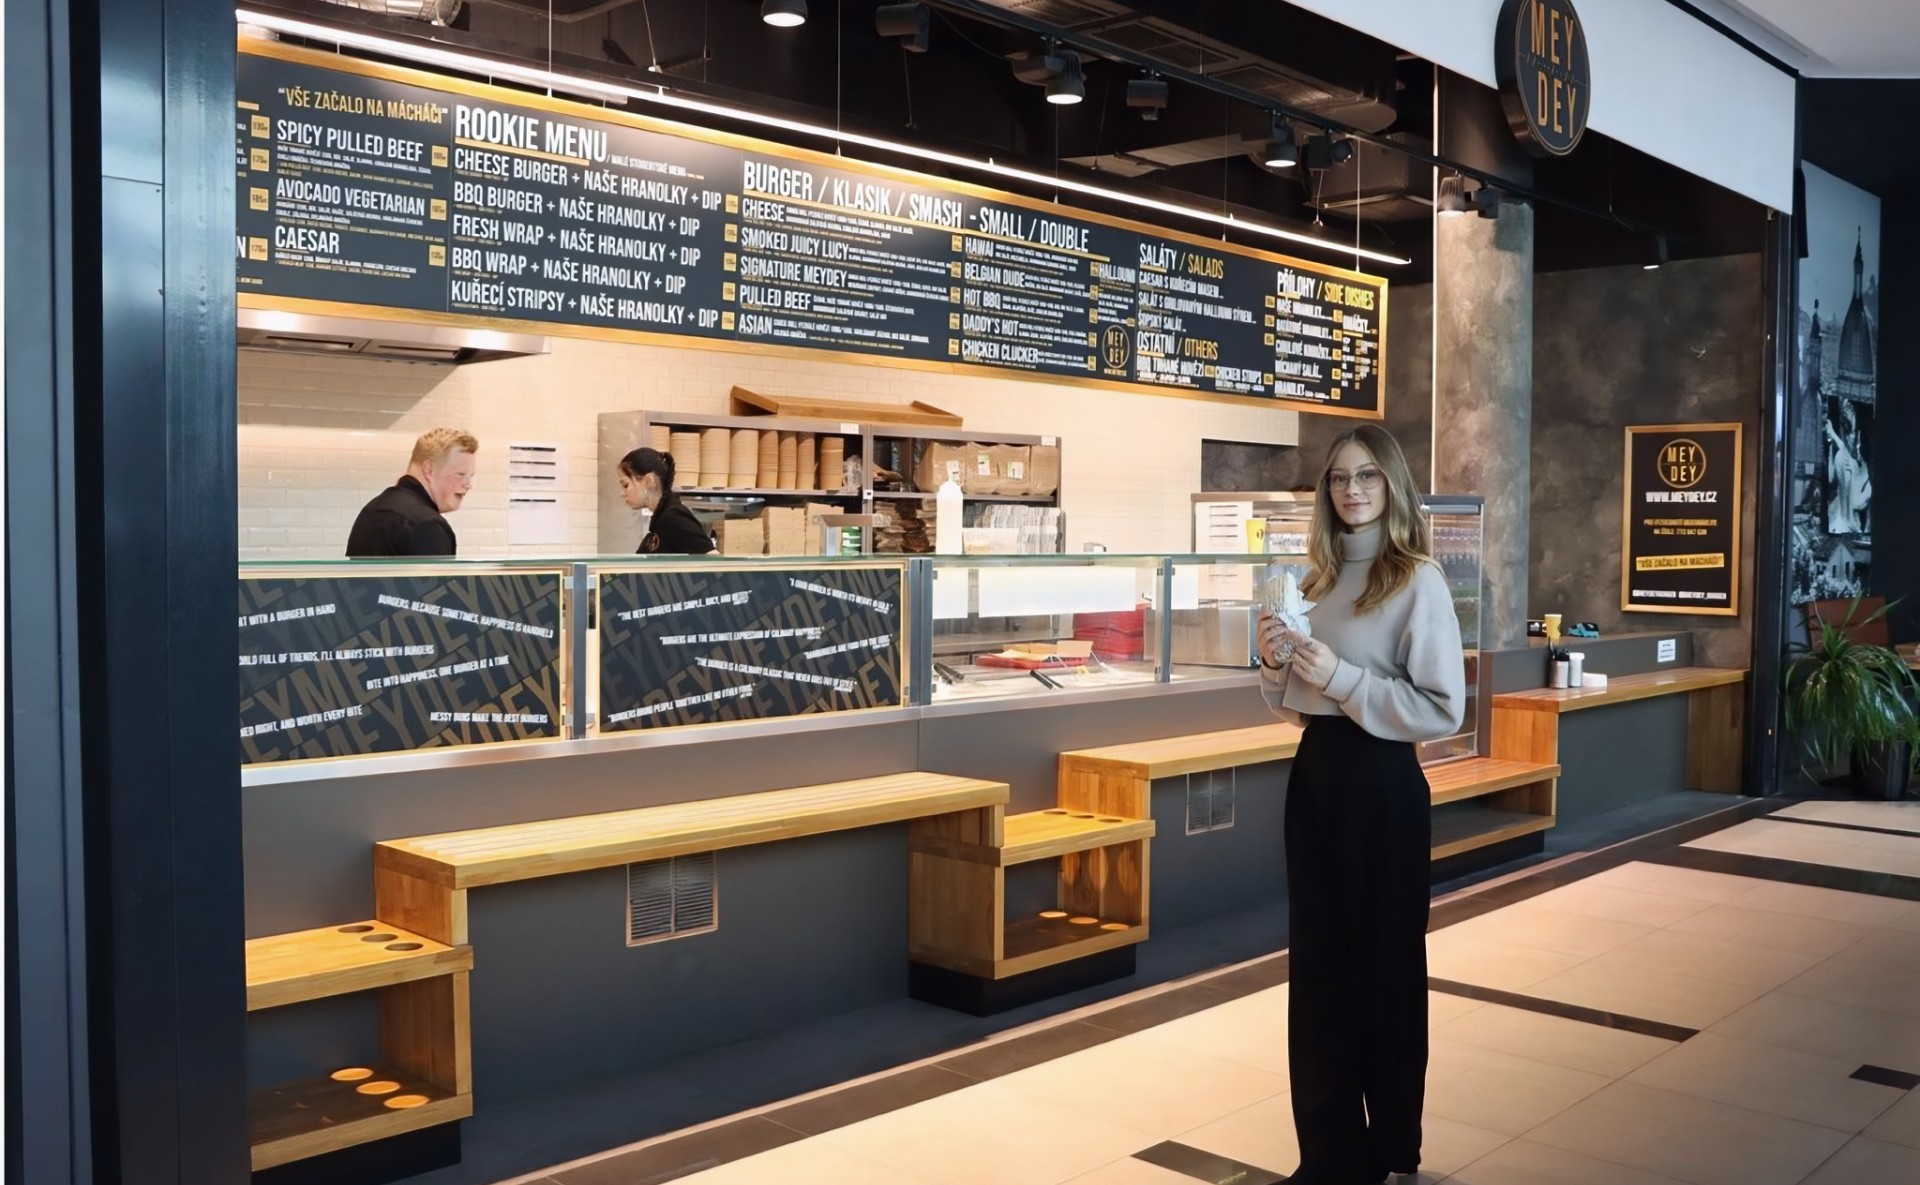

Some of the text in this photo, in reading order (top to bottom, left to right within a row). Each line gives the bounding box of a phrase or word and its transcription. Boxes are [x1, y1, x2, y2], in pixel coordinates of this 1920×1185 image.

[1531, 0, 1574, 71] MEY
[314, 90, 363, 114] ZAČALO
[367, 98, 384, 117] NA
[1538, 71, 1576, 139] DEY
[277, 119, 323, 146] SPICY
[327, 128, 383, 155] PULLED
[388, 137, 424, 162] BEEF
[456, 105, 539, 151] ROOKIE
[545, 121, 607, 163] MENU
[455, 149, 510, 177] CHEESE
[513, 159, 568, 186] BURGER
[571, 173, 581, 184] +
[584, 169, 618, 195] NAŠE
[621, 177, 688, 206] HRANOLKY
[691, 193, 699, 204] +
[703, 191, 722, 212] DIP
[276, 178, 426, 217] AVOCADO VEGETARIAN
[454, 181, 700, 237] BBQ BURGER + NAŠE HRANOLKY + DIP
[743, 198, 785, 222] CHEESE
[744, 160, 813, 202] BURGER
[818, 176, 829, 203] /
[834, 178, 892, 217] KLASIK
[894, 191, 906, 217] /
[910, 193, 963, 229] SMASH
[980, 207, 1025, 241] SMALL
[1028, 218, 1037, 242] /
[1040, 220, 1090, 253] DOUBLE
[275, 225, 340, 255] CAESAR
[453, 214, 499, 240] FRESH
[503, 223, 544, 246] WRAP
[548, 232, 557, 243] +
[560, 229, 595, 253] NAŠE
[599, 235, 666, 263] HRANOLKY
[669, 249, 678, 260] +
[681, 247, 701, 267] DIP
[742, 227, 787, 251] SMOKED
[790, 235, 820, 256] JUICY
[823, 239, 849, 261] LUCY
[452, 248, 482, 272] BBQ
[486, 254, 527, 276] WRAP
[531, 262, 540, 273] +
[544, 258, 579, 282] NAŠE
[583, 264, 652, 292] HRANOLKY
[654, 278, 662, 288] +
[666, 275, 686, 295] DIP
[741, 256, 801, 282] SIGNATURE
[804, 266, 848, 288] MEYDEY
[965, 263, 1001, 284] BELGIAN
[1003, 270, 1025, 288] DUDE
[1140, 243, 1177, 271] SALÁTY
[1188, 254, 1224, 280] SALADS
[1139, 271, 1163, 288] CAESAR
[1278, 268, 1316, 299] PŘÍLOHY
[1325, 282, 1344, 304] SIDE
[1345, 286, 1375, 311] DISHES
[452, 278, 718, 328] KUŘECÍ STRIPSY + NAŠE HRANOLKY + DIP
[740, 285, 782, 307] PULLED
[785, 292, 812, 311] BEEF
[964, 289, 981, 306] HOT
[983, 292, 1001, 310] BBQ
[1139, 290, 1158, 307] SALÁT
[739, 314, 773, 335] ASIAN
[1002, 321, 1019, 337] HOT
[1108, 329, 1124, 348] MEY
[962, 340, 999, 360] CHICKEN
[1002, 344, 1039, 364] CLUCKER
[1110, 348, 1124, 364] DEY
[1138, 331, 1175, 355] OSTATNÍ
[1185, 338, 1219, 361] OTHERS
[1668, 447, 1696, 463] MEY
[1671, 466, 1696, 482] DEY
[1646, 492, 1718, 503] WWW.MEYDEY.CZ
[259, 654, 277, 665] FULL
[278, 653, 288, 664] OF
[323, 708, 346, 722] EVERY
